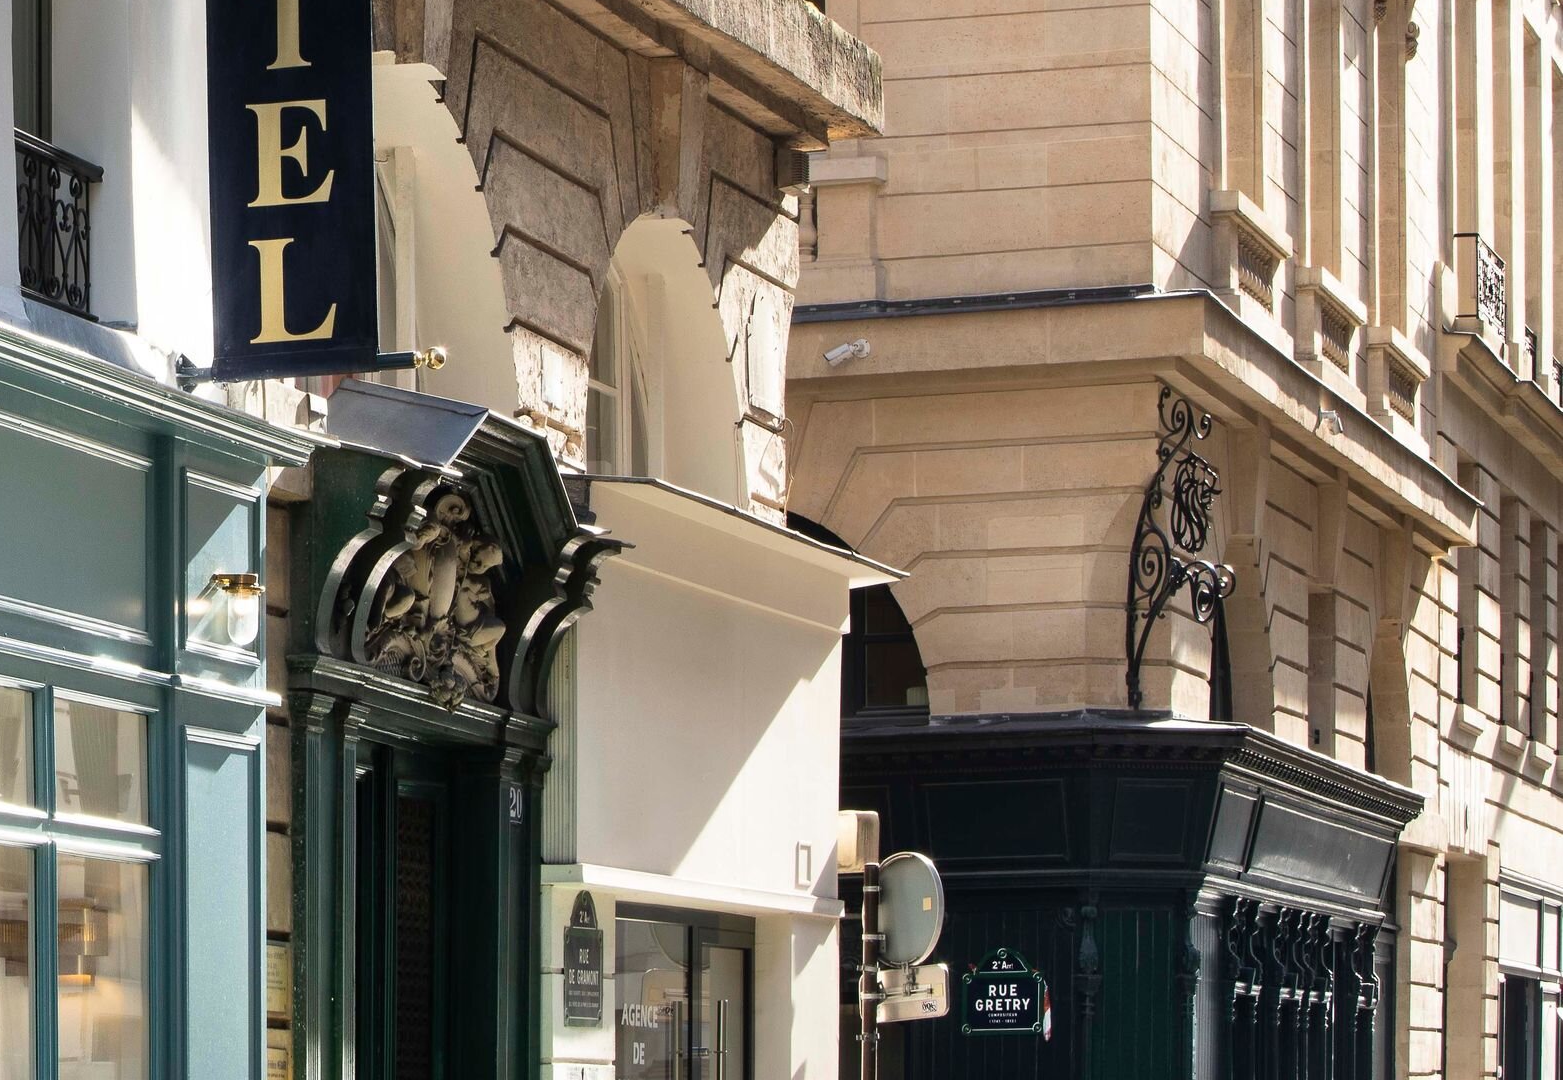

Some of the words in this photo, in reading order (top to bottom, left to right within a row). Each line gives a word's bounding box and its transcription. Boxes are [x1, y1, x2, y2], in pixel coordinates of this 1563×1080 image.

[509, 786, 523, 819] 20
[988, 984, 1018, 997] RUE
[621, 1003, 658, 1029] AGENCE
[975, 998, 1031, 1011] GRETRY
[633, 1041, 645, 1065] DE
